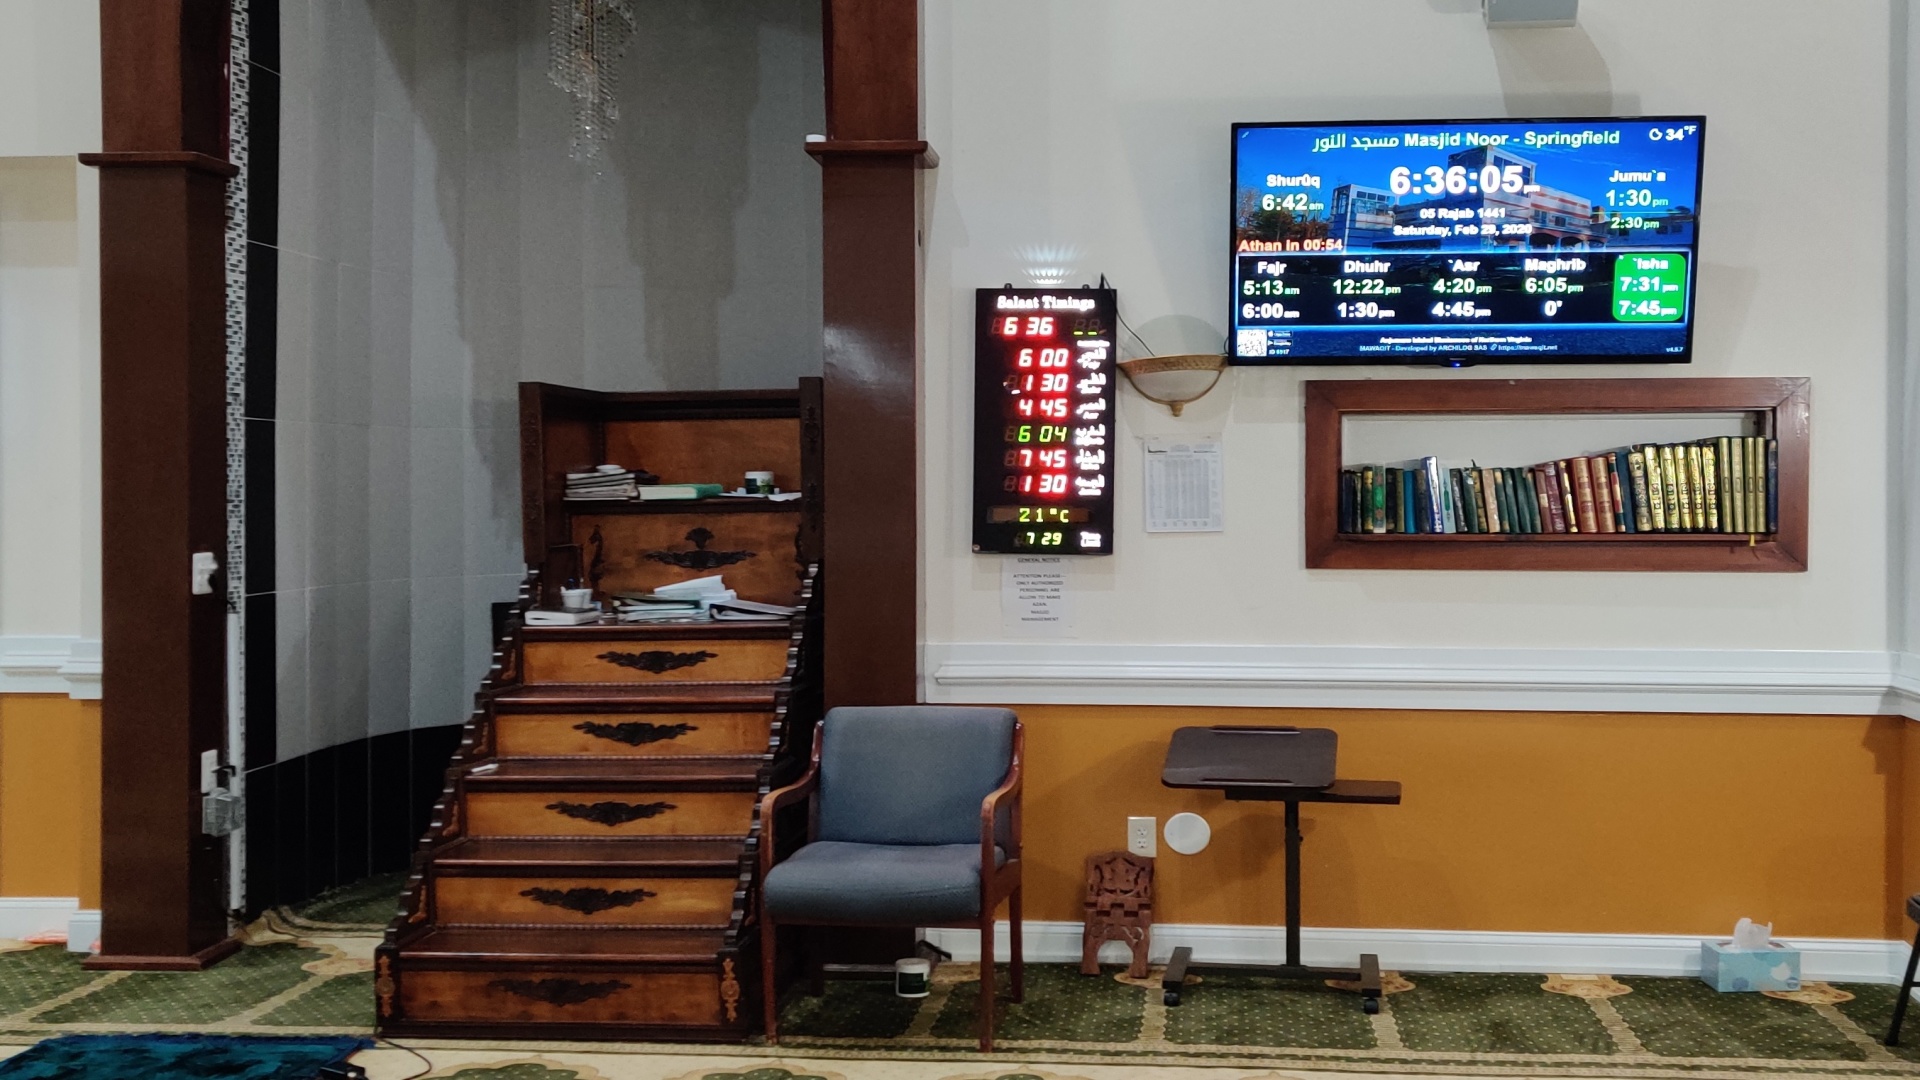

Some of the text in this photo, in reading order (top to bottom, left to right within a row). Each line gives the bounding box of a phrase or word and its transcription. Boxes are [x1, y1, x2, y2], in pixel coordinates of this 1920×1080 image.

[1312, 133, 1400, 152] مسجد النور
[1404, 133, 1460, 149] Masjid
[1466, 132, 1509, 146] Noor
[1524, 131, 1620, 148] Springfield
[1420, 207, 1506, 221] 05 Rajab 1441
[1393, 224, 1452, 237] Saturday,
[1455, 224, 1478, 235] Feb
[1502, 224, 1533, 234] 2020
[1238, 239, 1282, 252] Athan
[1303, 238, 1344, 251] 00:54
[1257, 261, 1288, 276] Fajr
[1344, 260, 1392, 274] Dhuhr
[1525, 258, 1587, 274] Maghrib
[1042, 296, 1095, 312] Timings
